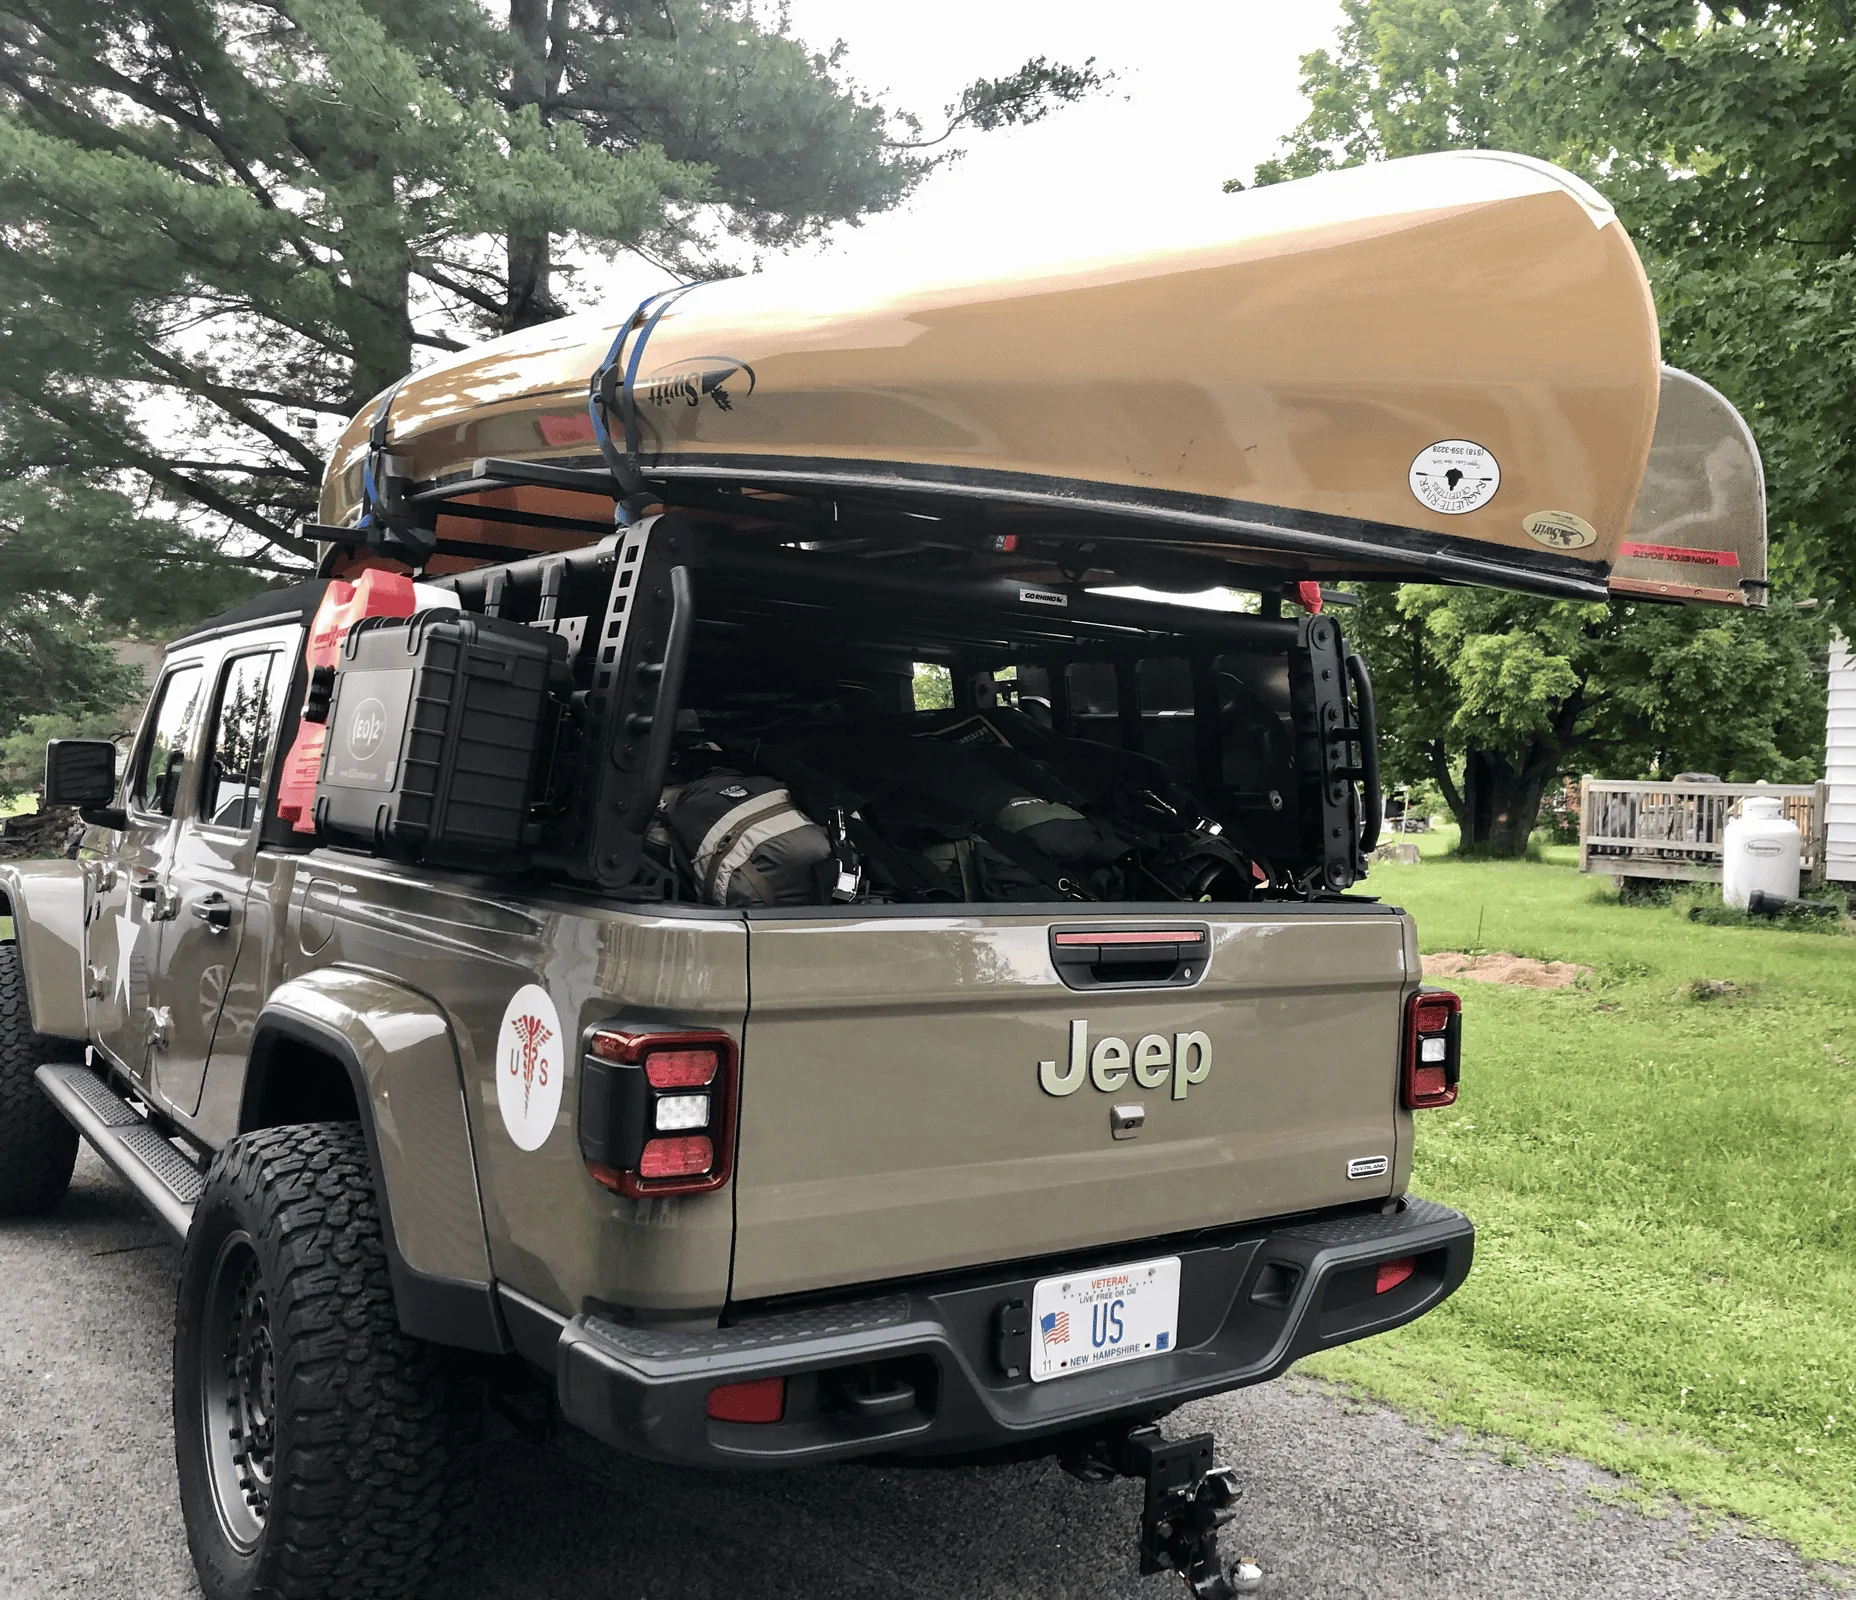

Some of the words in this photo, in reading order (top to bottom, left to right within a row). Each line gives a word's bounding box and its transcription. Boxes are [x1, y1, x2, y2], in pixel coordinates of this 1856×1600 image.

[649, 372, 700, 407] Swift
[1432, 446, 1464, 455] 359-3228
[1465, 447, 1484, 456] (518)
[1420, 478, 1439, 506] RIVER
[1432, 482, 1471, 500] OUTFITTERS
[1440, 481, 1486, 511] RAQUETTE
[1531, 522, 1560, 540] Swift
[1633, 550, 1664, 561] BOATS
[1664, 553, 1719, 566] HORNBECK
[1025, 592, 1035, 600] GO
[1035, 594, 1056, 602] RHINO
[510, 1049, 520, 1076] U
[538, 1058, 549, 1087] S
[1038, 1019, 1213, 1100] Jeep
[1350, 1163, 1387, 1172] OVERLAND
[1091, 1275, 1129, 1289] VETERAN
[1079, 1294, 1094, 1304] LIVE
[1096, 1292, 1113, 1301] FREE
[1115, 1290, 1125, 1298] OR
[1126, 1287, 1137, 1296] DIE
[1092, 1299, 1125, 1348] US
[1069, 1354, 1089, 1367] NEW
[1093, 1343, 1140, 1362] HAMPSHIRE
[1042, 1359, 1052, 1371] 11
